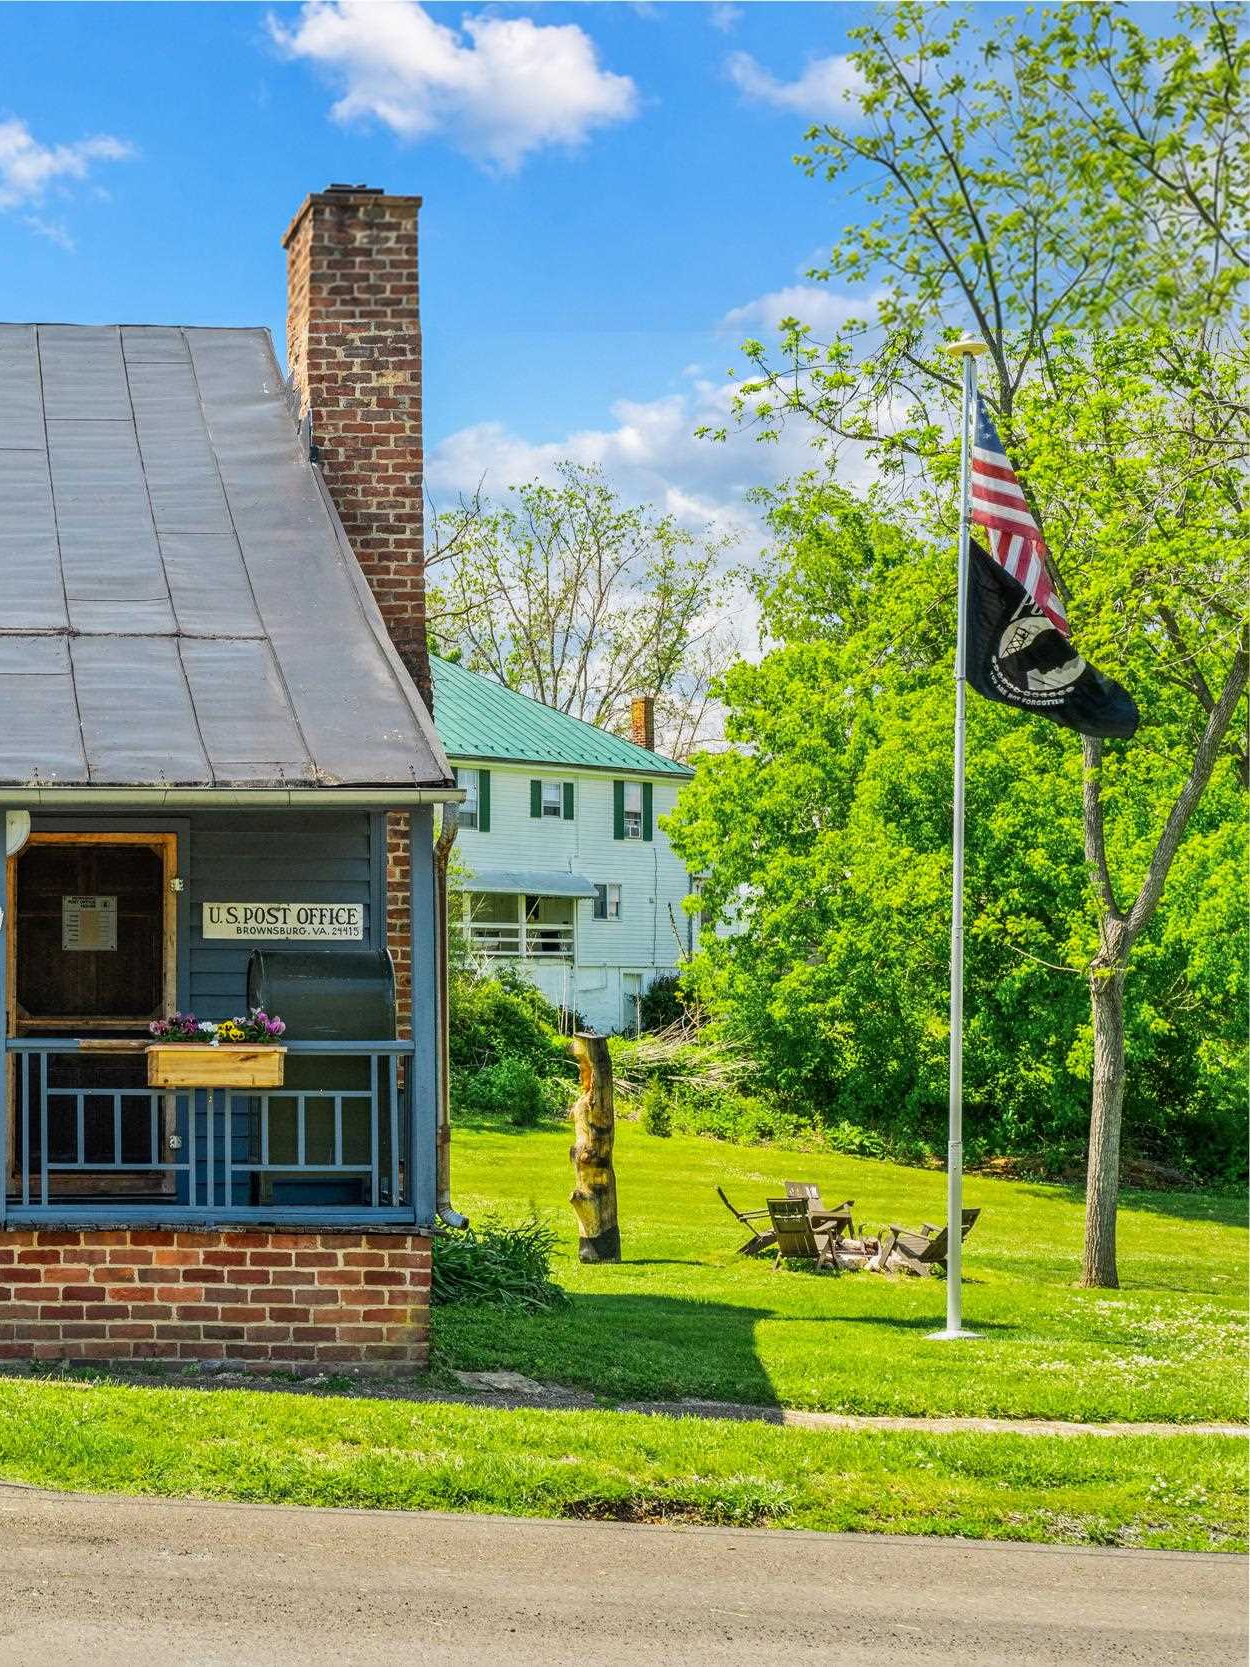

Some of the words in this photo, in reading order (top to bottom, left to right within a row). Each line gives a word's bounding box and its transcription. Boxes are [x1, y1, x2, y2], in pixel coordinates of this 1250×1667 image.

[1022, 698, 1065, 706] FORGOTTEN
[296, 907, 359, 926] OFFICE
[332, 926, 360, 937] 24415
